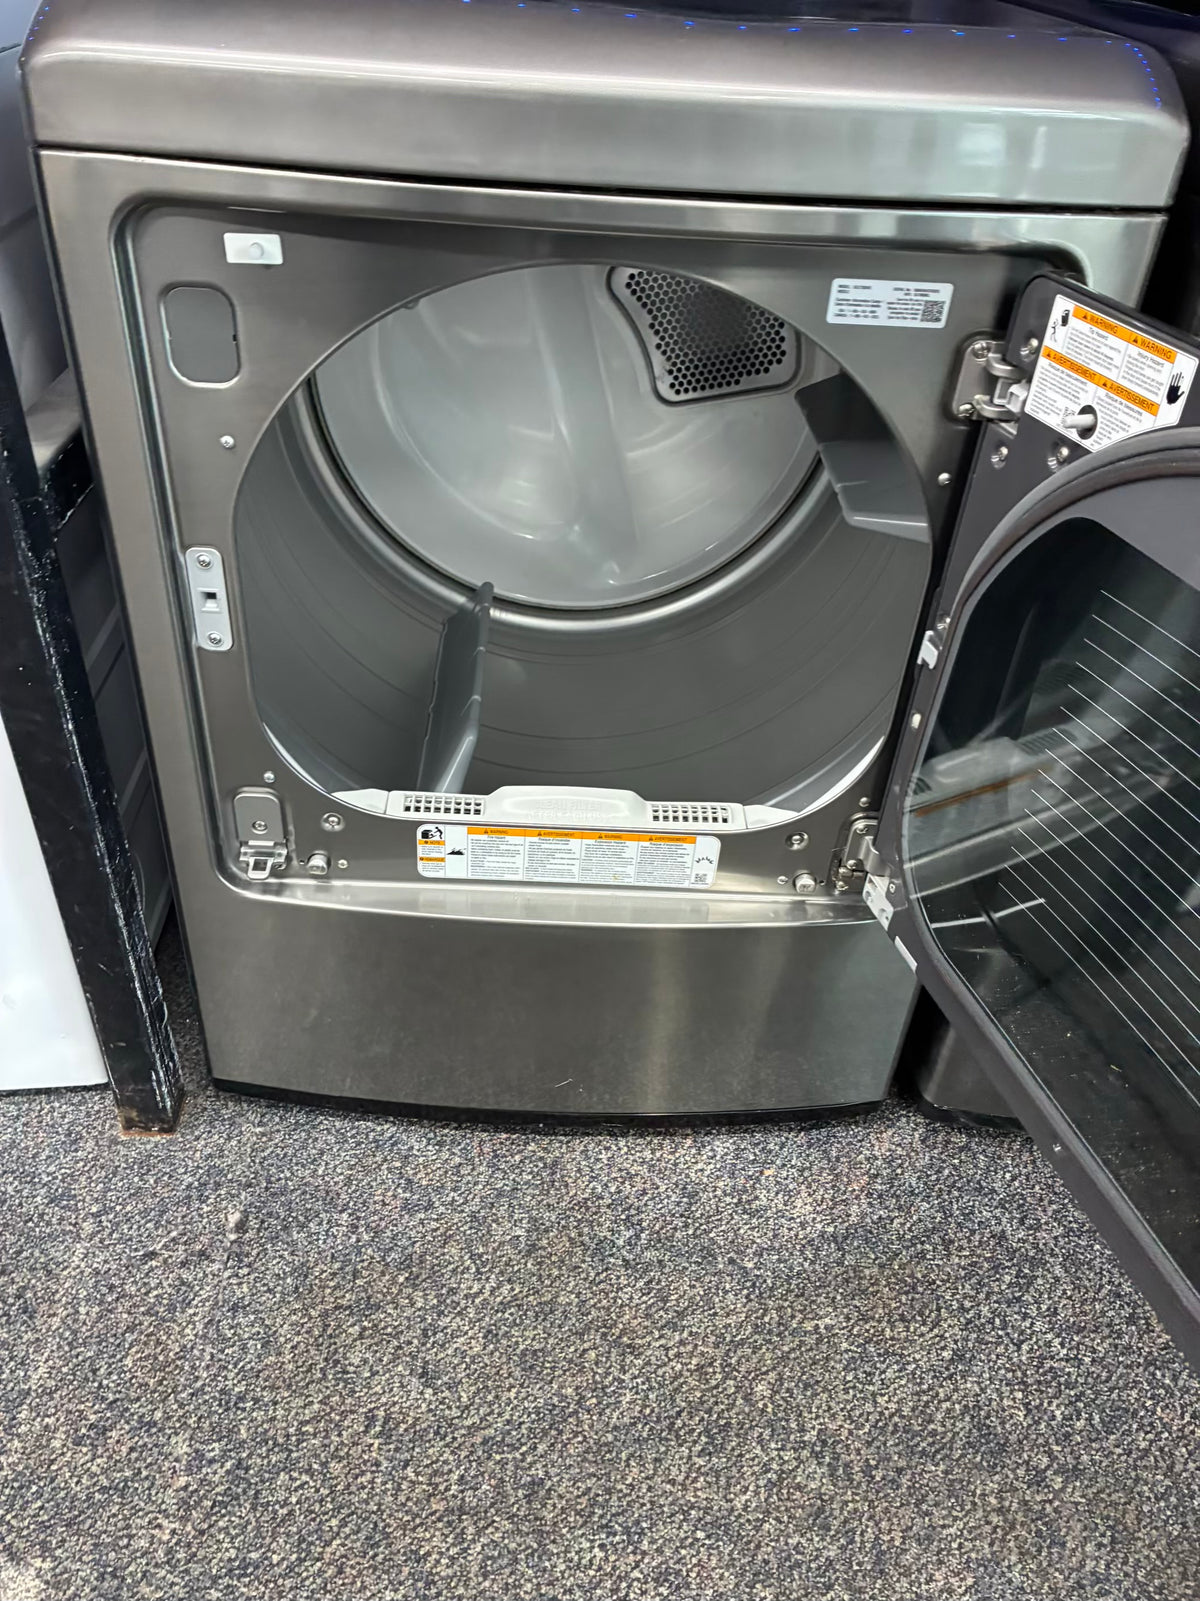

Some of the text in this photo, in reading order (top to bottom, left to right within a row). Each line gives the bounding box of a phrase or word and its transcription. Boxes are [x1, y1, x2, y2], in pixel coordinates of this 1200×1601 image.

[1089, 313, 1118, 335] WARNING
[1140, 337, 1172, 360] WARNING
[1052, 353, 1097, 381] AVERTISSEMENT
[1109, 382, 1155, 411] AVERTISSEMENT
